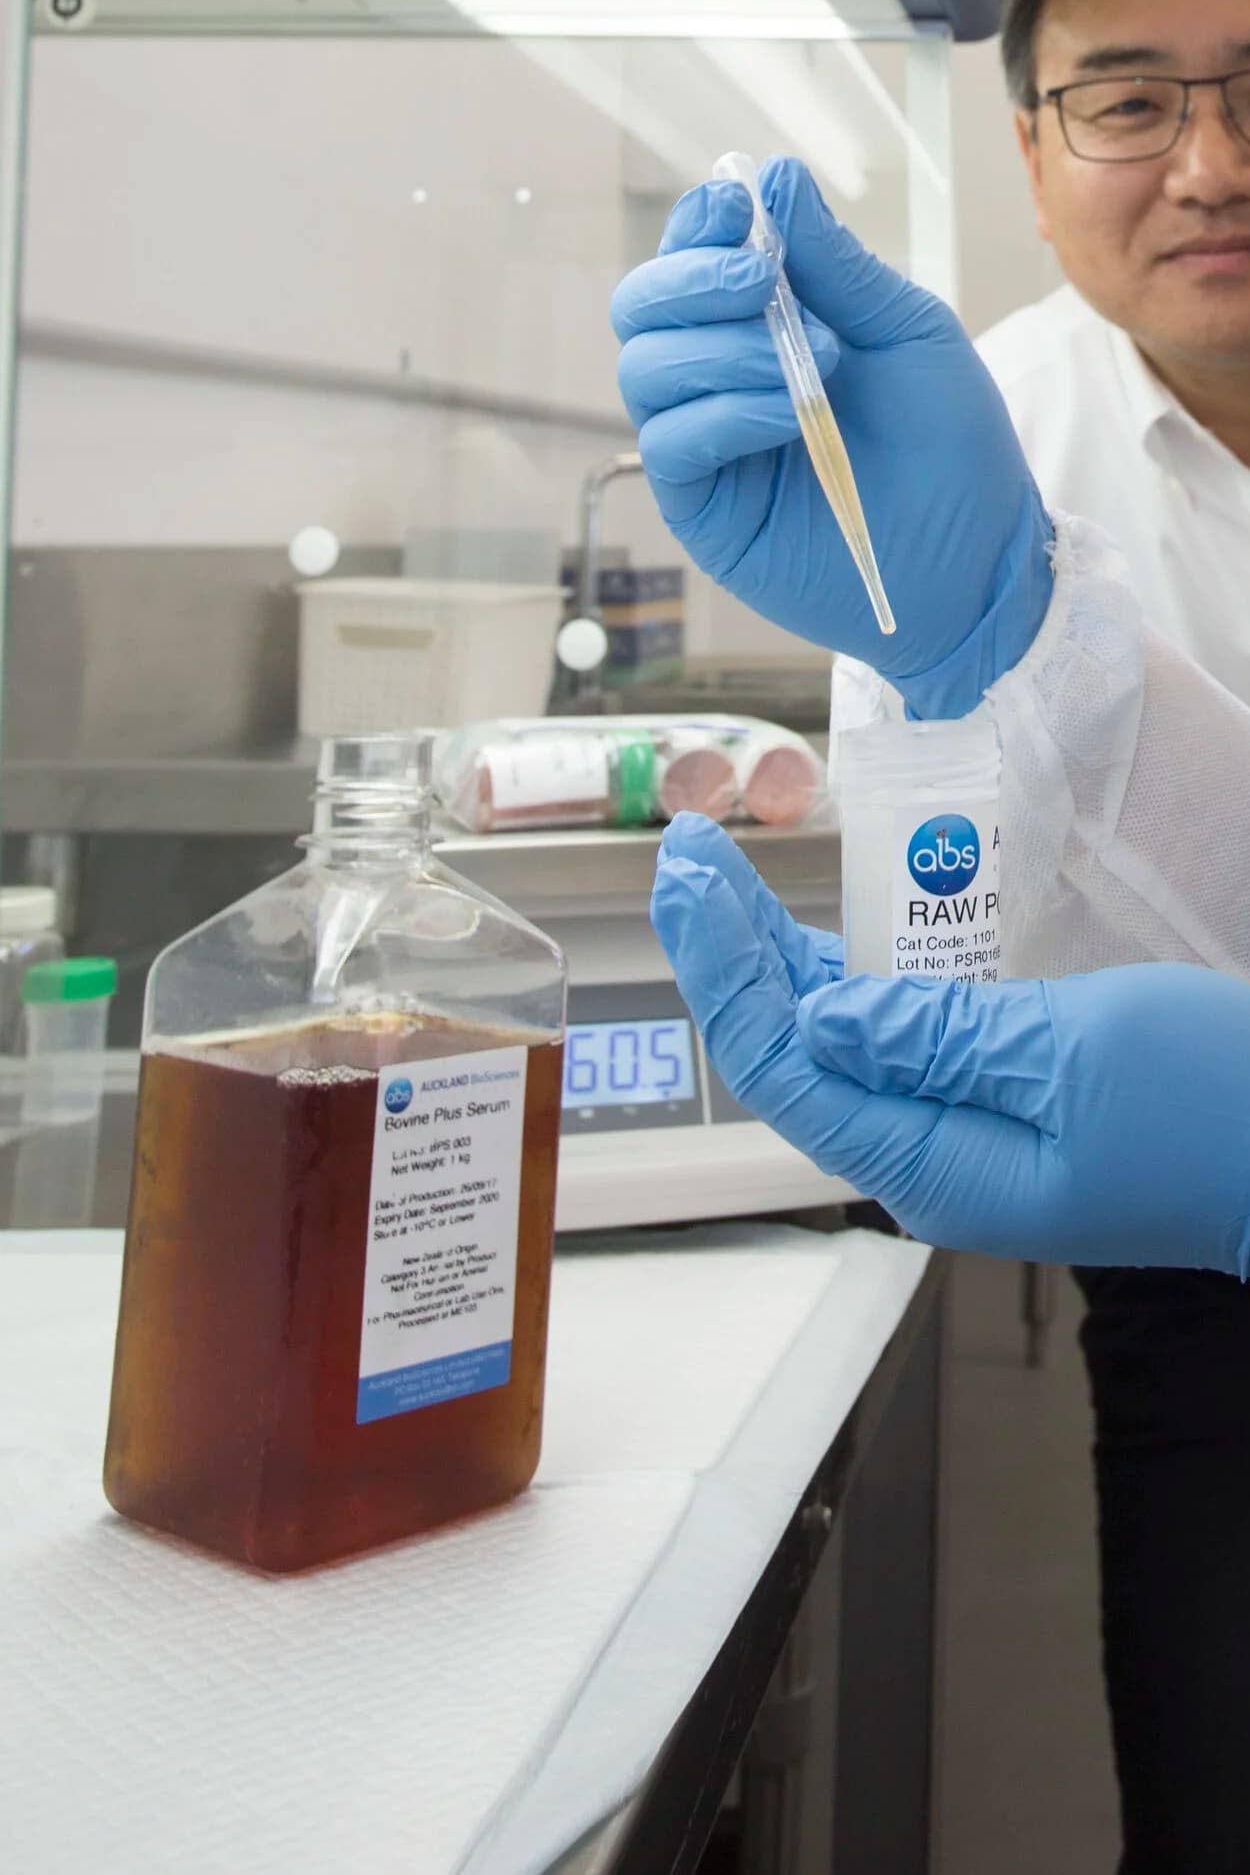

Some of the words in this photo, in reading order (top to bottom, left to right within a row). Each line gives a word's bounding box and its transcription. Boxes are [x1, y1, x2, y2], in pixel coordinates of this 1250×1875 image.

[913, 838, 976, 873] abs
[909, 896, 977, 926] RAW
[896, 936, 921, 951] Cat
[926, 935, 968, 951] Code:
[973, 930, 995, 946] 1101
[897, 957, 921, 970] Lot
[924, 957, 949, 970] No:
[982, 968, 997, 983] 5kg
[420, 1075, 469, 1093] AUCKLAND
[384, 1113, 430, 1132] Bovine
[434, 1106, 462, 1124] Plus
[466, 1099, 511, 1118] Serum
[391, 1165, 408, 1177] Net
[459, 1152, 471, 1165] kg
[374, 1212, 401, 1227] Expiry
[430, 1197, 475, 1215] September
[399, 1226, 408, 1236] at
[438, 1218, 446, 1228] or
[449, 1212, 475, 1225] Lower
[402, 1255, 420, 1266] New
[422, 1249, 453, 1262] Zealad
[455, 1243, 478, 1255] Origin
[391, 1283, 404, 1294] Not
[407, 1280, 418, 1290] For
[422, 1274, 450, 1285] Huan
[452, 1272, 459, 1280] or
